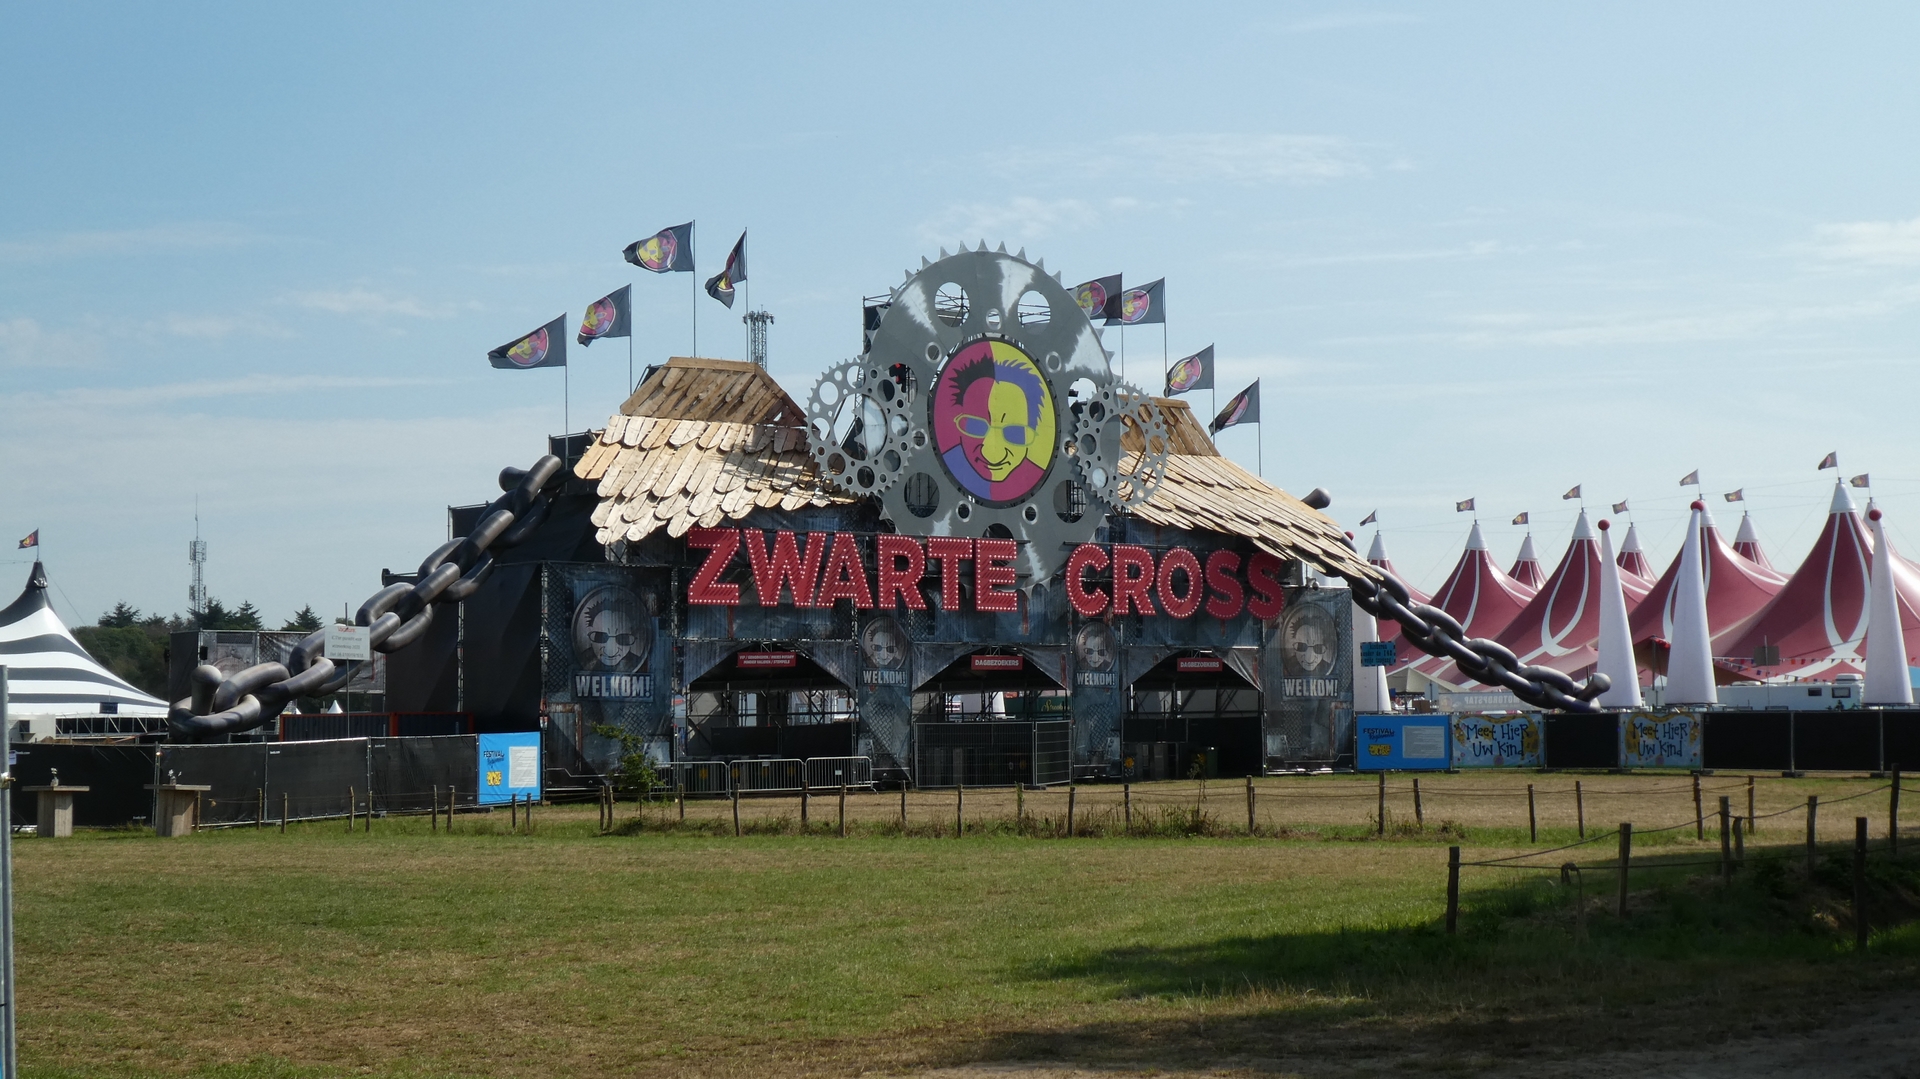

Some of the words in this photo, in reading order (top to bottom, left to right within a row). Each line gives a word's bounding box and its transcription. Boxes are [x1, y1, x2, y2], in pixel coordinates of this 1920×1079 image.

[687, 527, 1018, 612] ZWARTE
[1065, 542, 1285, 620] CROSS
[975, 659, 1020, 667] DAGBEZOEKERS
[863, 670, 906, 684] WELKOM!
[1076, 672, 1115, 686] WELKOM!
[575, 675, 651, 697] WELKOM!
[1284, 678, 1338, 697] WELKOM!
[1466, 723, 1497, 741] Meet
[1633, 722, 1659, 740] Meet
[1472, 741, 1493, 757] Uw
[1637, 740, 1655, 757] Uw
